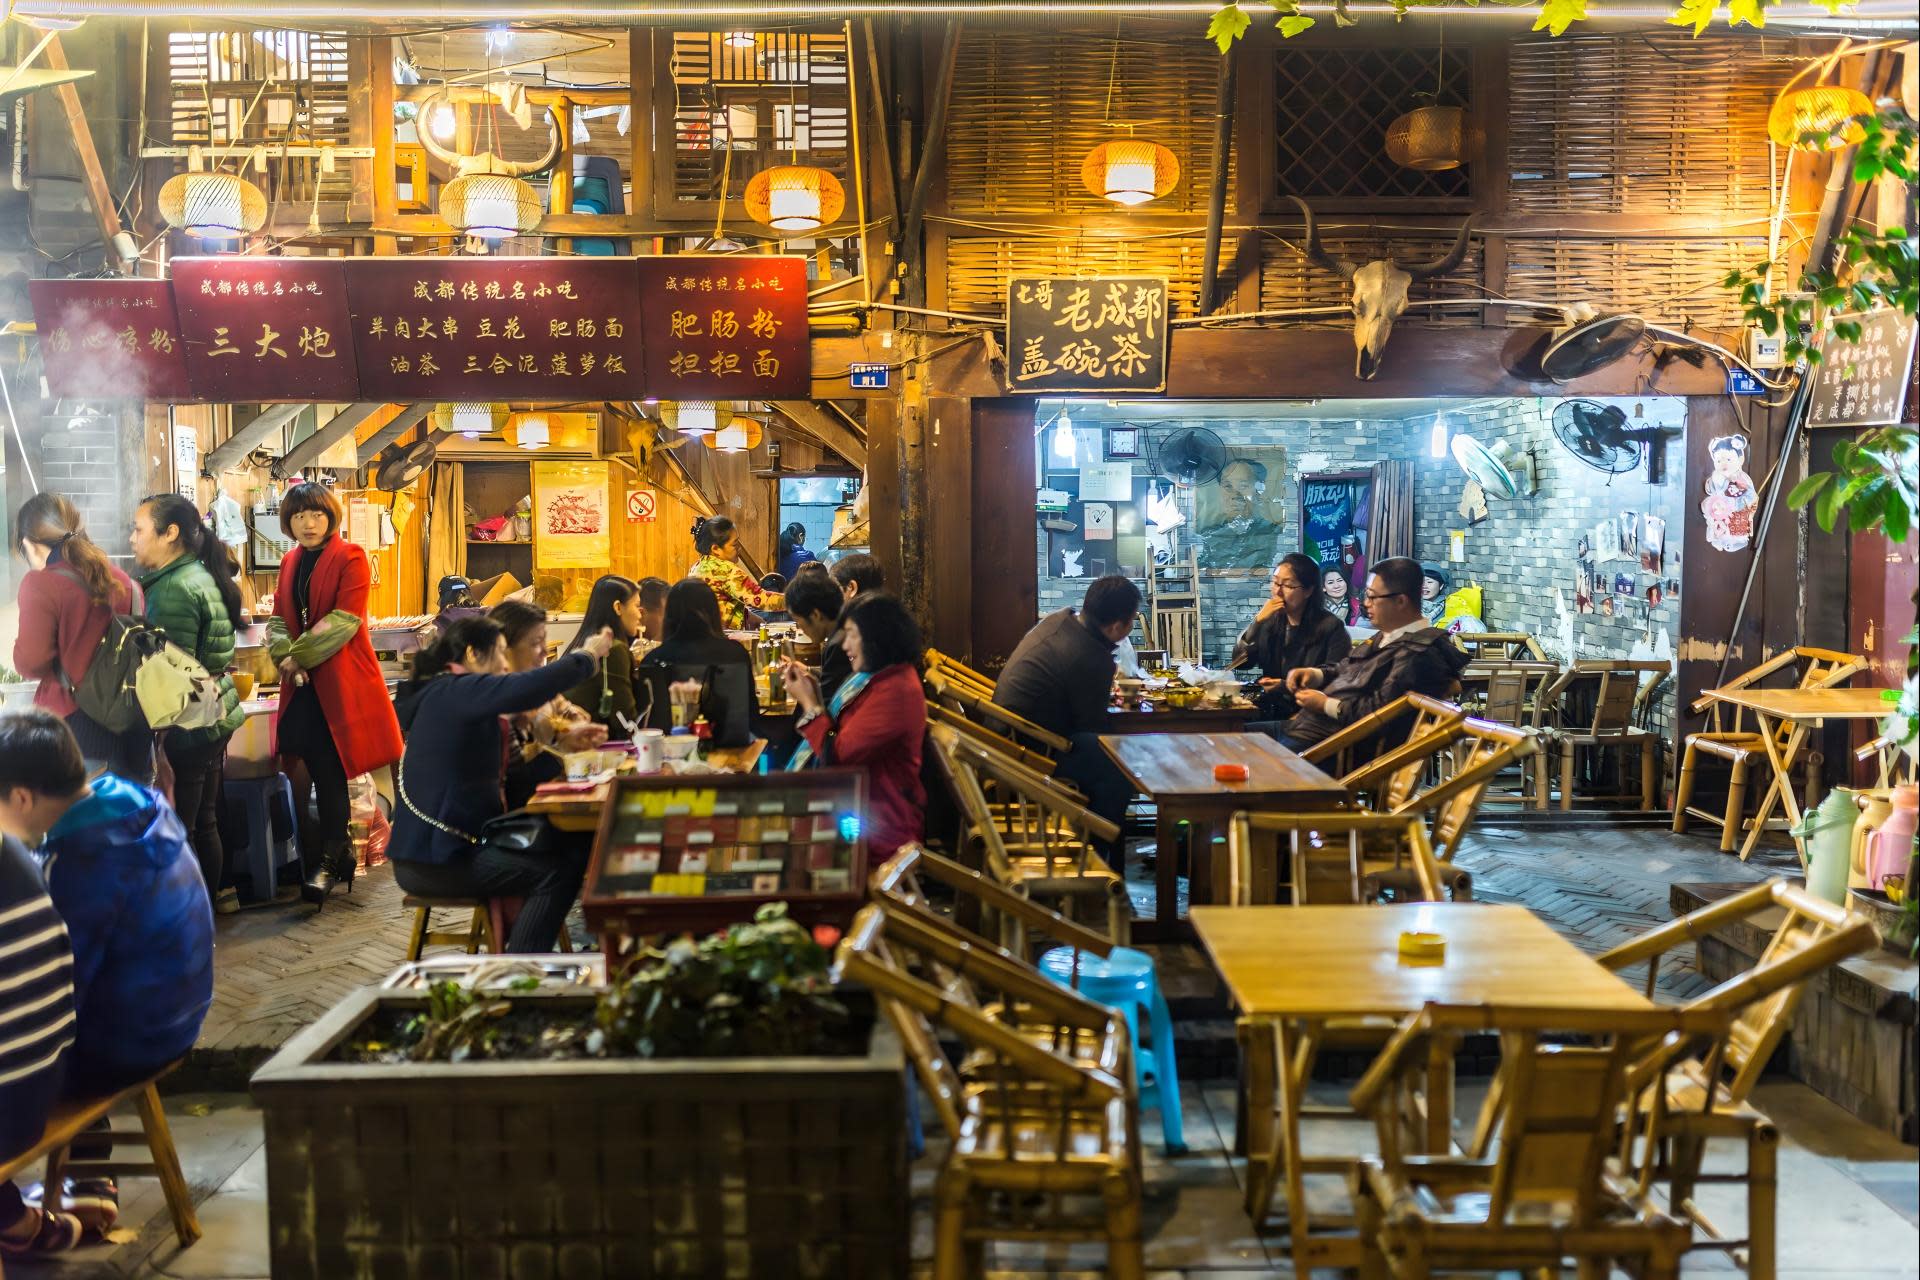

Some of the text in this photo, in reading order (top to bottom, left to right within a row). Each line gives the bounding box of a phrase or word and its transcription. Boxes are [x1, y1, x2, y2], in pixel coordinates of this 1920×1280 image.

[201, 279, 322, 296] 成都传统名小吃
[413, 280, 579, 301] 成都传统名小吃
[665, 276, 784, 292] 成都传统名小吃
[670, 307, 783, 339] 肥肠粉
[1016, 280, 1162, 340] 七哥 老成都
[207, 323, 336, 358] 三大炮
[369, 316, 624, 340] 羊肉大串 豆花 肥肠面
[391, 352, 441, 377] 油茶
[463, 352, 539, 375] 三合泥
[669, 350, 780, 378] 担担面
[1016, 332, 1152, 381] 盖碗茶
